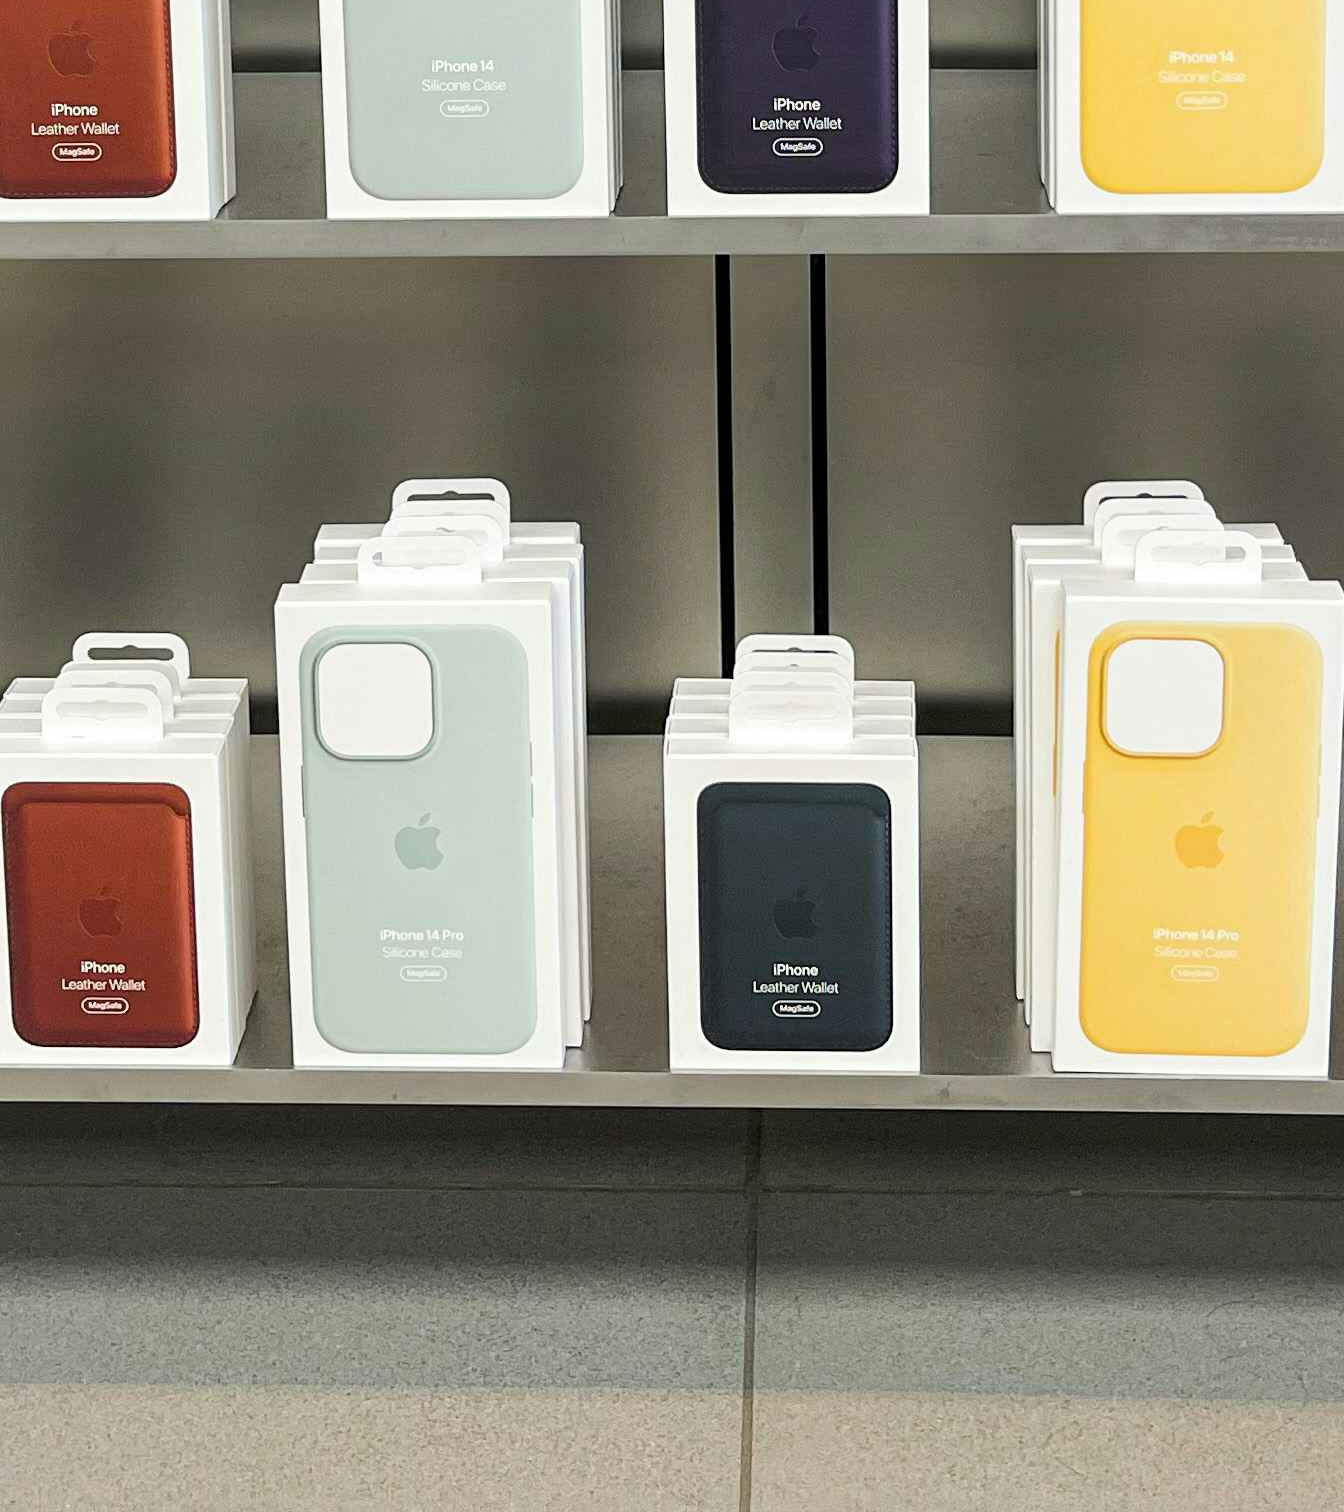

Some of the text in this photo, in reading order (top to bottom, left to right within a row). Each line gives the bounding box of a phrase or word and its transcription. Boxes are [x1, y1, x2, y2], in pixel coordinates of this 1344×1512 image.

[1169, 51, 1233, 63] iPhone 14
[432, 60, 494, 72] iPhone 14
[422, 79, 506, 91] Silicone Case
[52, 104, 98, 116] iPhone
[774, 98, 820, 111] iPhone
[32, 123, 119, 135] Leather Wallet
[753, 118, 842, 130] Leather Wallet
[380, 929, 464, 940] iPhone 14 Pro
[1153, 928, 1199, 940] iPhone
[1218, 930, 1239, 941] Pro
[81, 961, 125, 973] iPhone
[774, 964, 818, 976] iPhone
[62, 979, 145, 990] Leather Wallet
[753, 981, 838, 993] Leather Wallet
